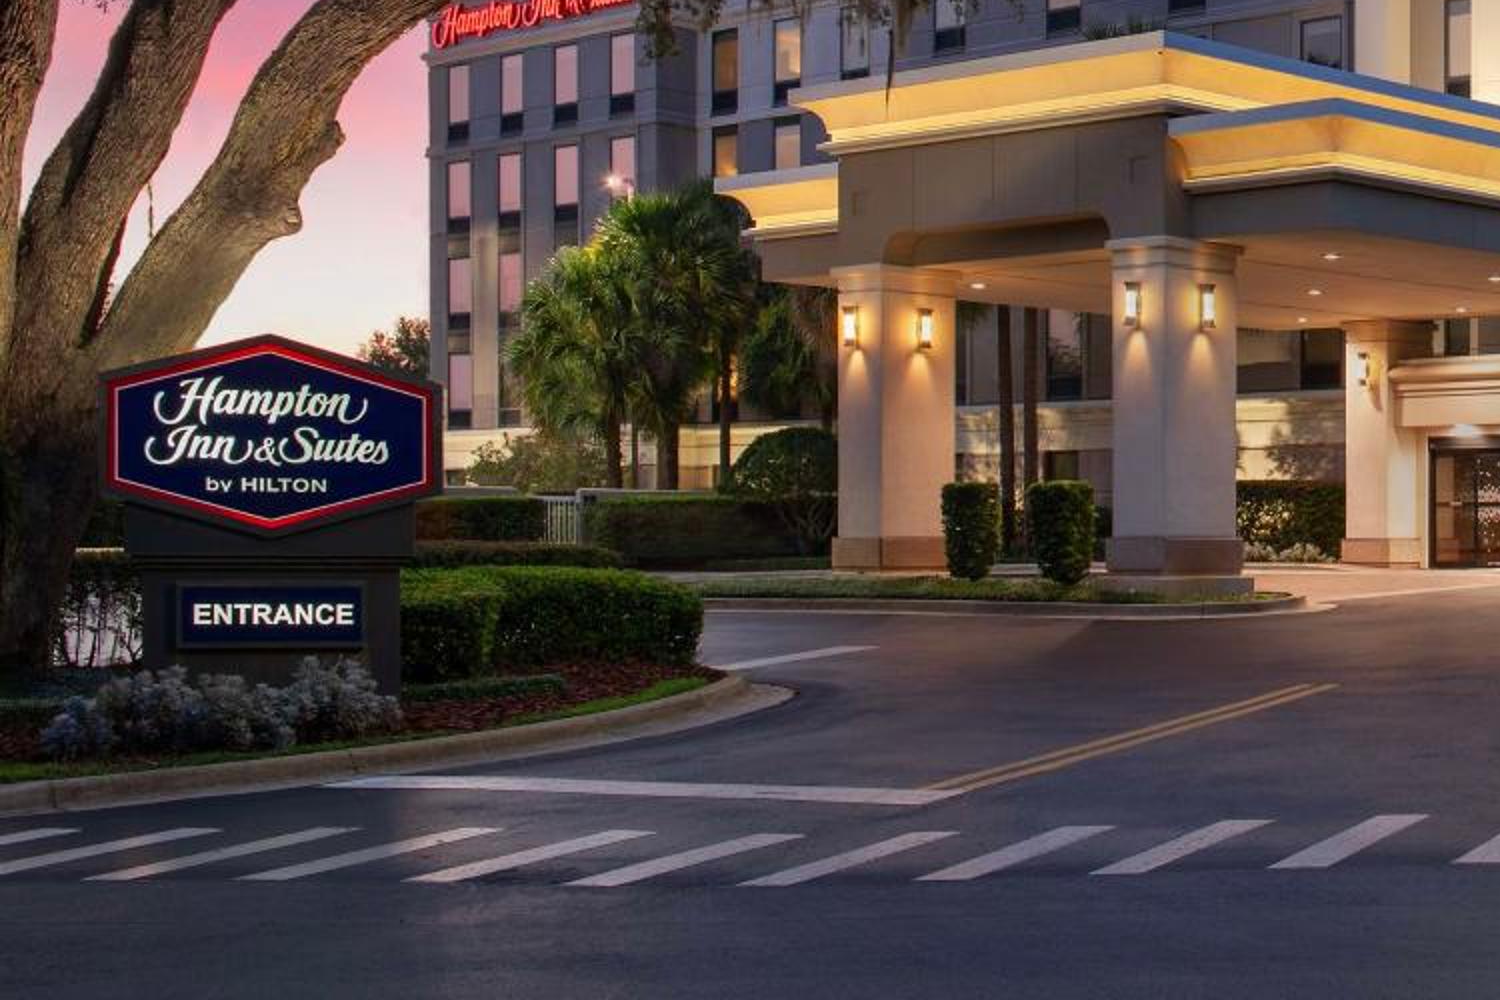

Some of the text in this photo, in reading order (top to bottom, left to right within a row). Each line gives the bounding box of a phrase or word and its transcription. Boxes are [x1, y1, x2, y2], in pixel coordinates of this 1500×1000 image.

[432, 1, 521, 48] Hampton
[153, 376, 368, 425] Hampton
[144, 425, 389, 467] Inn & Suites
[205, 476, 328, 493] by HILTON
[193, 603, 354, 626] ENTRANCE
